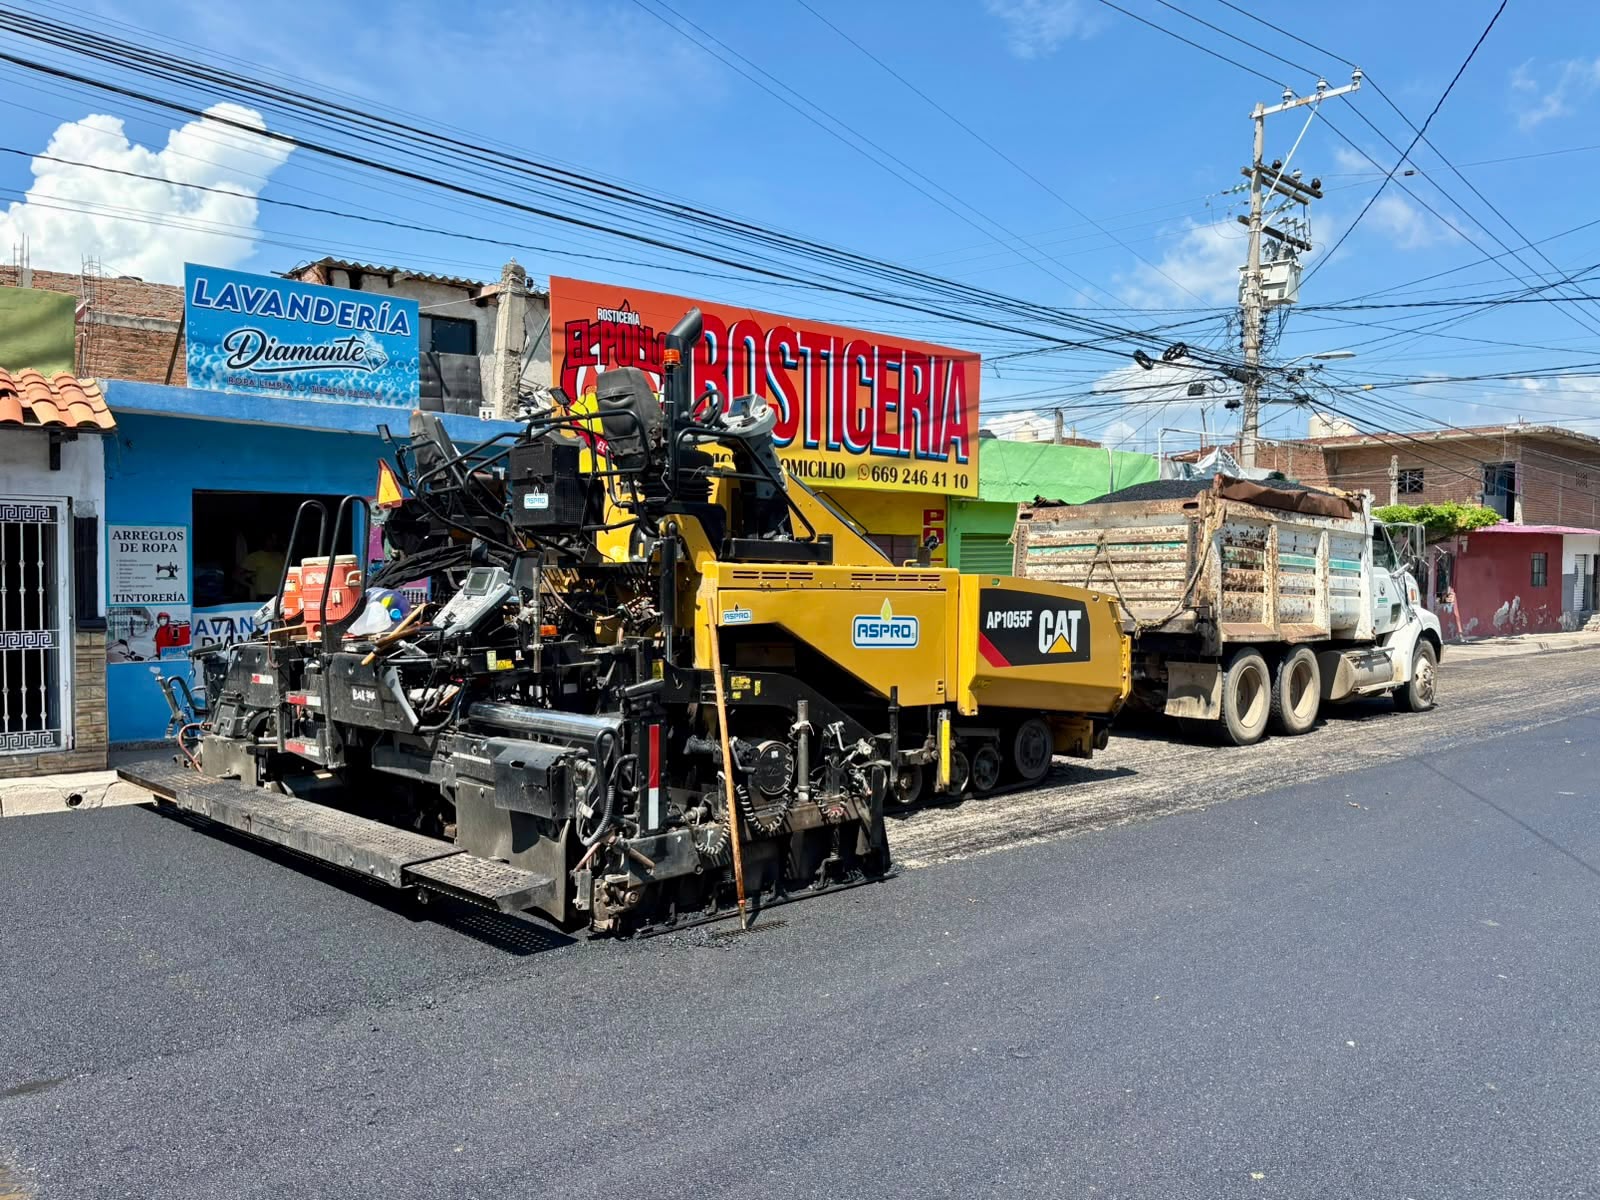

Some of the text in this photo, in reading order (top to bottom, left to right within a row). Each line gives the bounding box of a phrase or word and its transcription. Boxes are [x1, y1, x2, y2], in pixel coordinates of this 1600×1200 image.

[192, 278, 411, 336] LAVANDERÍA
[597, 307, 641, 326] ROSTICERÍA
[223, 328, 365, 370] Diamante
[691, 313, 970, 465] ROSTICERIA
[780, 457, 969, 490] OMICILIO 669 246 41 10
[112, 530, 184, 541] ARREGLOS
[120, 542, 178, 553] DE ROPA
[113, 591, 186, 603] TINTORERÍA
[986, 610, 1033, 630] AP1055F
[857, 623, 911, 639] ASPRO
[1038, 609, 1082, 654] CAT
